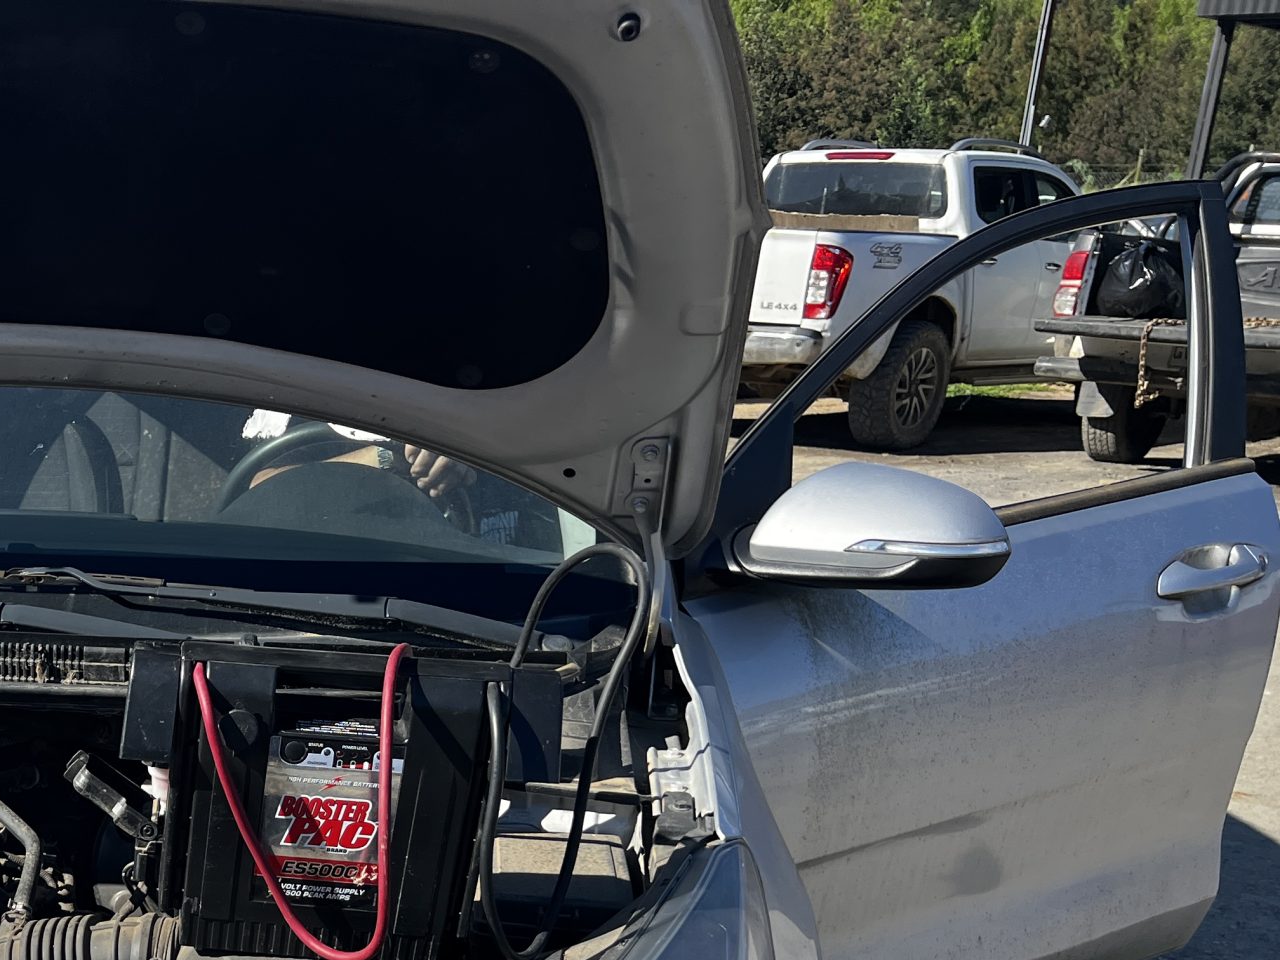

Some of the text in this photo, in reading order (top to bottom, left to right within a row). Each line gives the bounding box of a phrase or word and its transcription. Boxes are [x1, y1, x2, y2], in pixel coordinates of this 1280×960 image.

[302, 777, 352, 787] PERFORMANCE
[277, 794, 371, 822] BOOSTER
[282, 817, 376, 849] PAC
[280, 882, 365, 896] VOLT POWER SUPPLY
[282, 889, 351, 901] 500 PEAK AMPS
